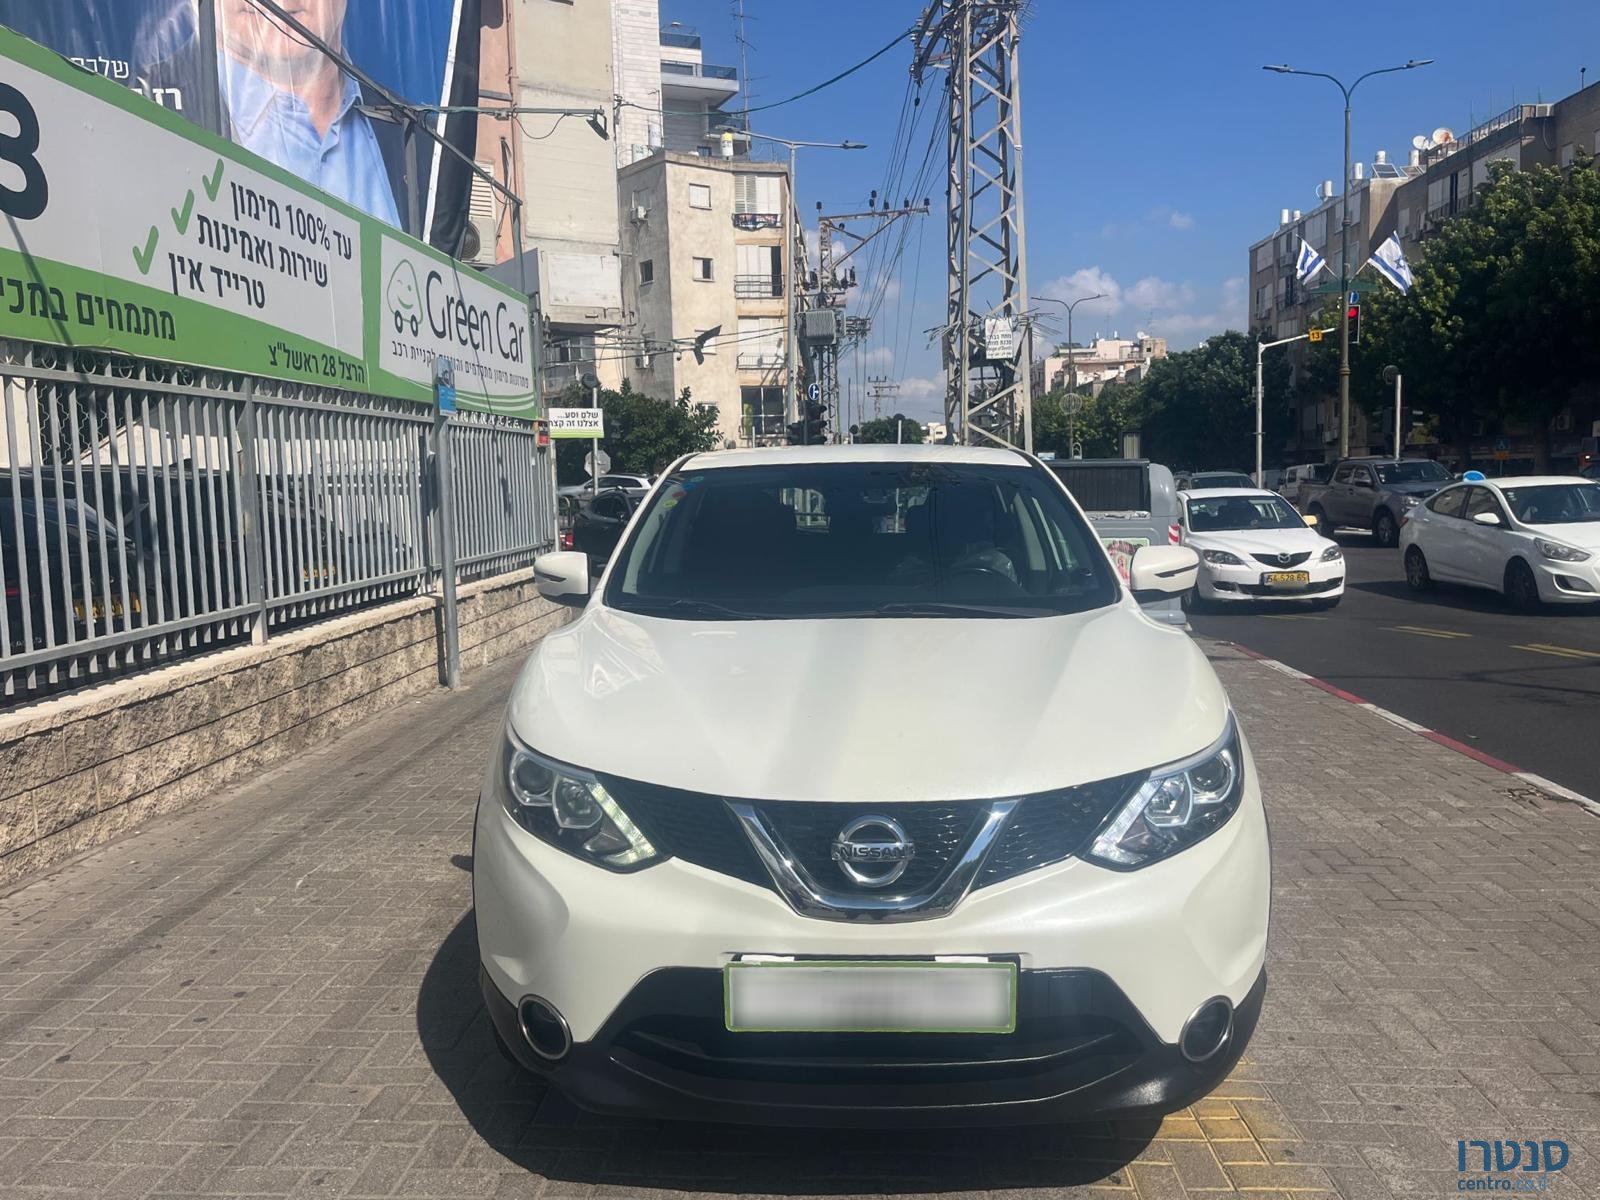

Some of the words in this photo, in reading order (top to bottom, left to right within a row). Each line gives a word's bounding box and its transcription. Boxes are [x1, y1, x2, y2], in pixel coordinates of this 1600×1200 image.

[230, 181, 281, 230] מימון
[197, 214, 275, 270] ואמינות
[286, 204, 330, 251] 100%
[333, 230, 352, 260] עד
[168, 252, 205, 296] אין
[279, 246, 328, 288] שירות
[210, 265, 265, 309] טרייד
[76, 292, 176, 341] מתמחים
[426, 270, 493, 355] Green
[496, 302, 525, 364] Car
[392, 340, 408, 358] רכב
[1311, 331, 1320, 340] 13
[268, 341, 319, 374] ראשל"צ
[321, 353, 337, 378] 28
[338, 355, 365, 383] הרצל
[578, 419, 599, 427] אצלנו
[581, 411, 599, 419] שלם
[839, 846, 906, 859] NISSAN
